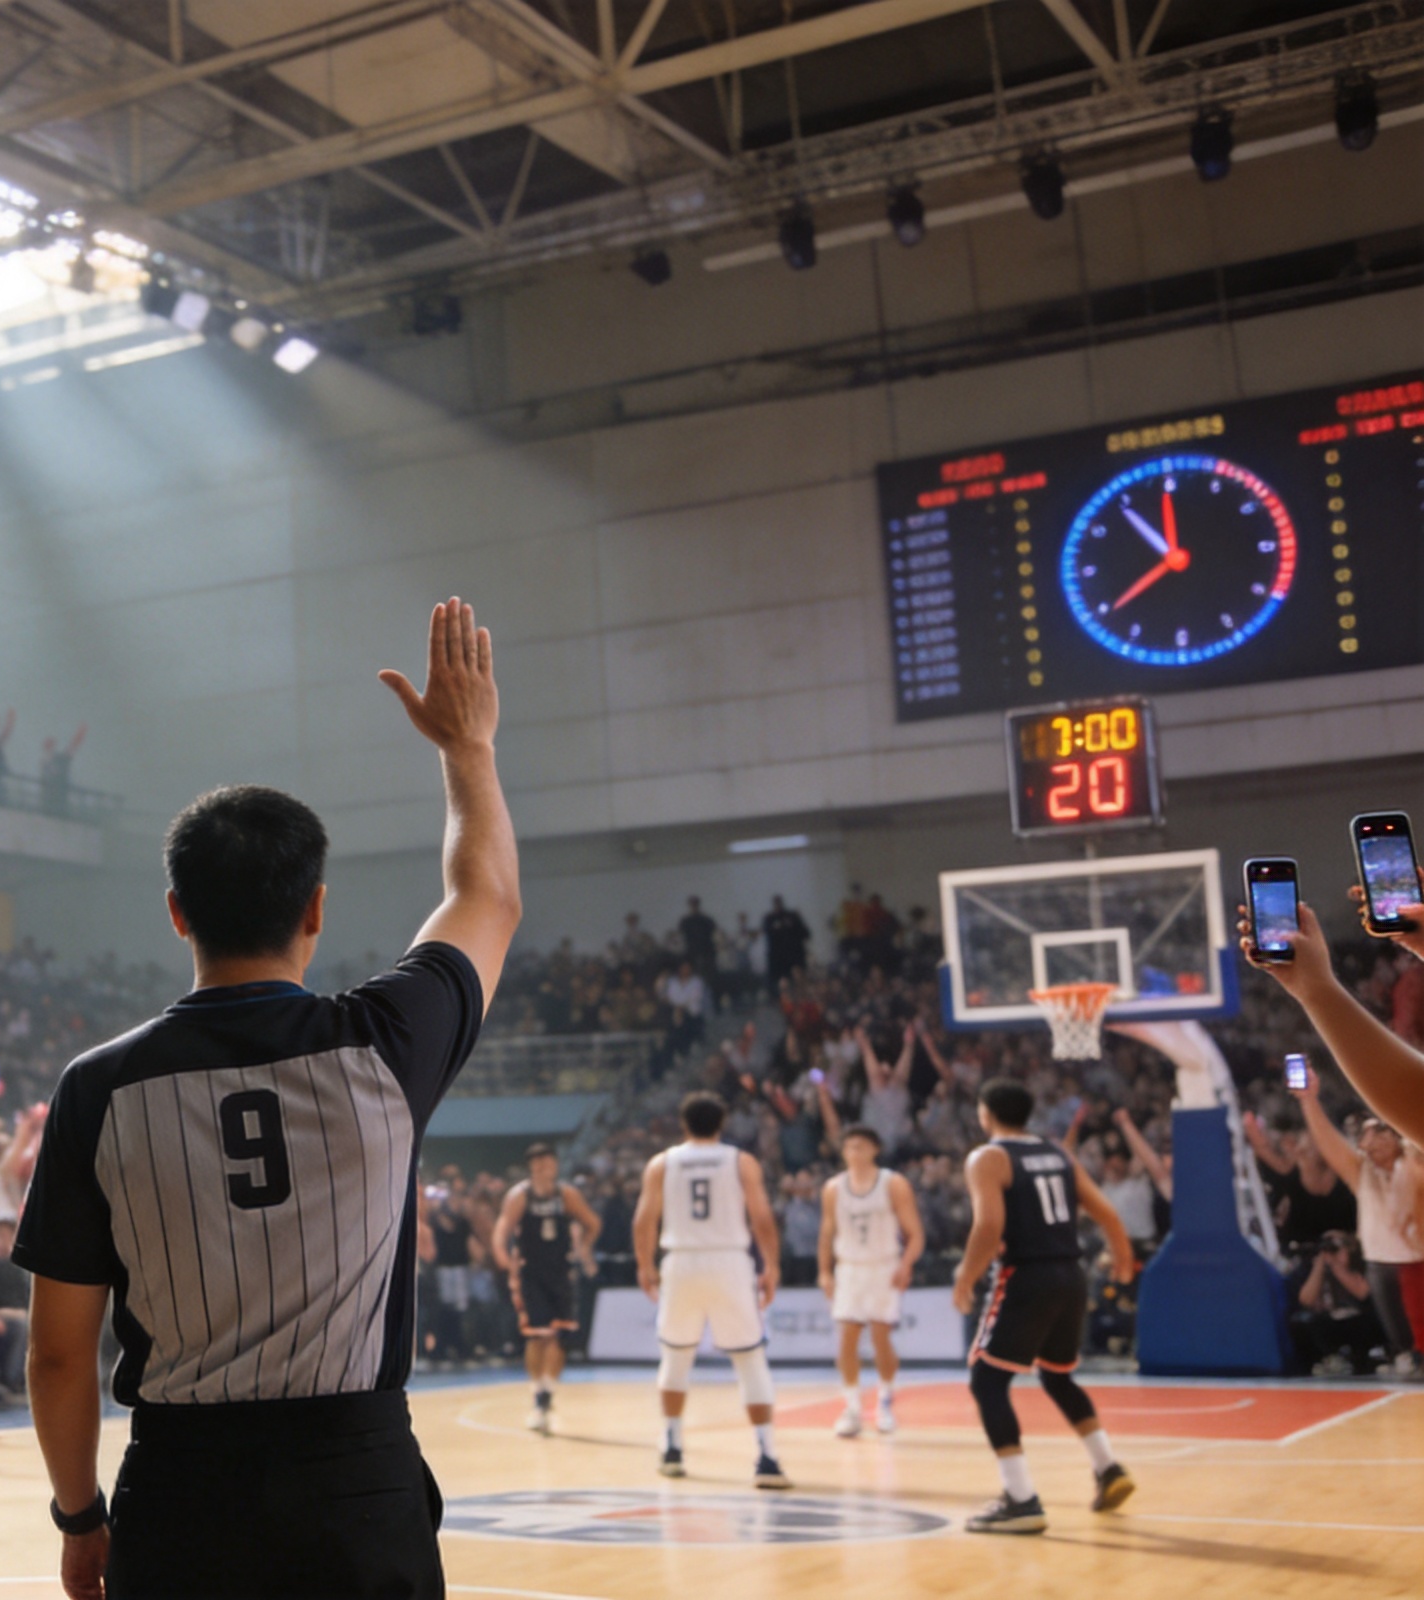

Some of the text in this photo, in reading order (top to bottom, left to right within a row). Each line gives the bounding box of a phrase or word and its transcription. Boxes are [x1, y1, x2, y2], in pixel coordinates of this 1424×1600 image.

[1048, 757, 1126, 819] 20
[219, 1088, 292, 1211] 9
[1034, 1174, 1070, 1225] 11
